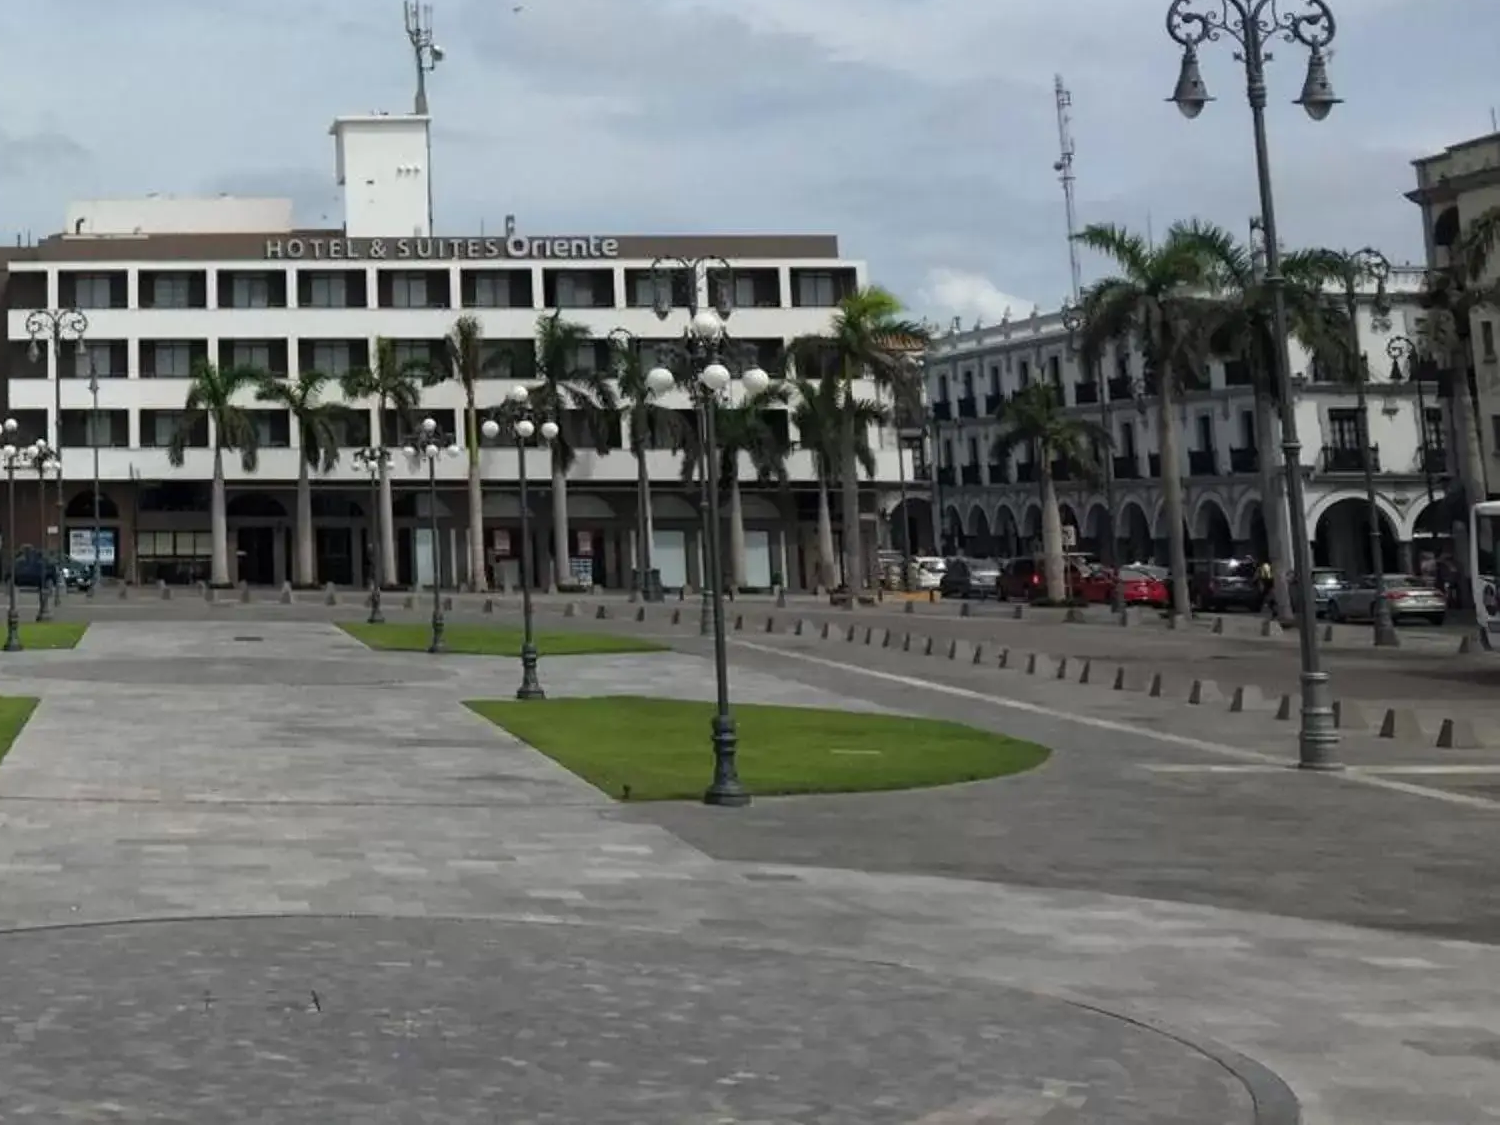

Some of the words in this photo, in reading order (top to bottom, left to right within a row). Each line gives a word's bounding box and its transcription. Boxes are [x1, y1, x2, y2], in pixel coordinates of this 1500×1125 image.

[266, 238, 359, 259] HOTEL
[369, 238, 388, 259] &
[397, 238, 499, 259] SUITES
[506, 233, 620, 258] Oriente
